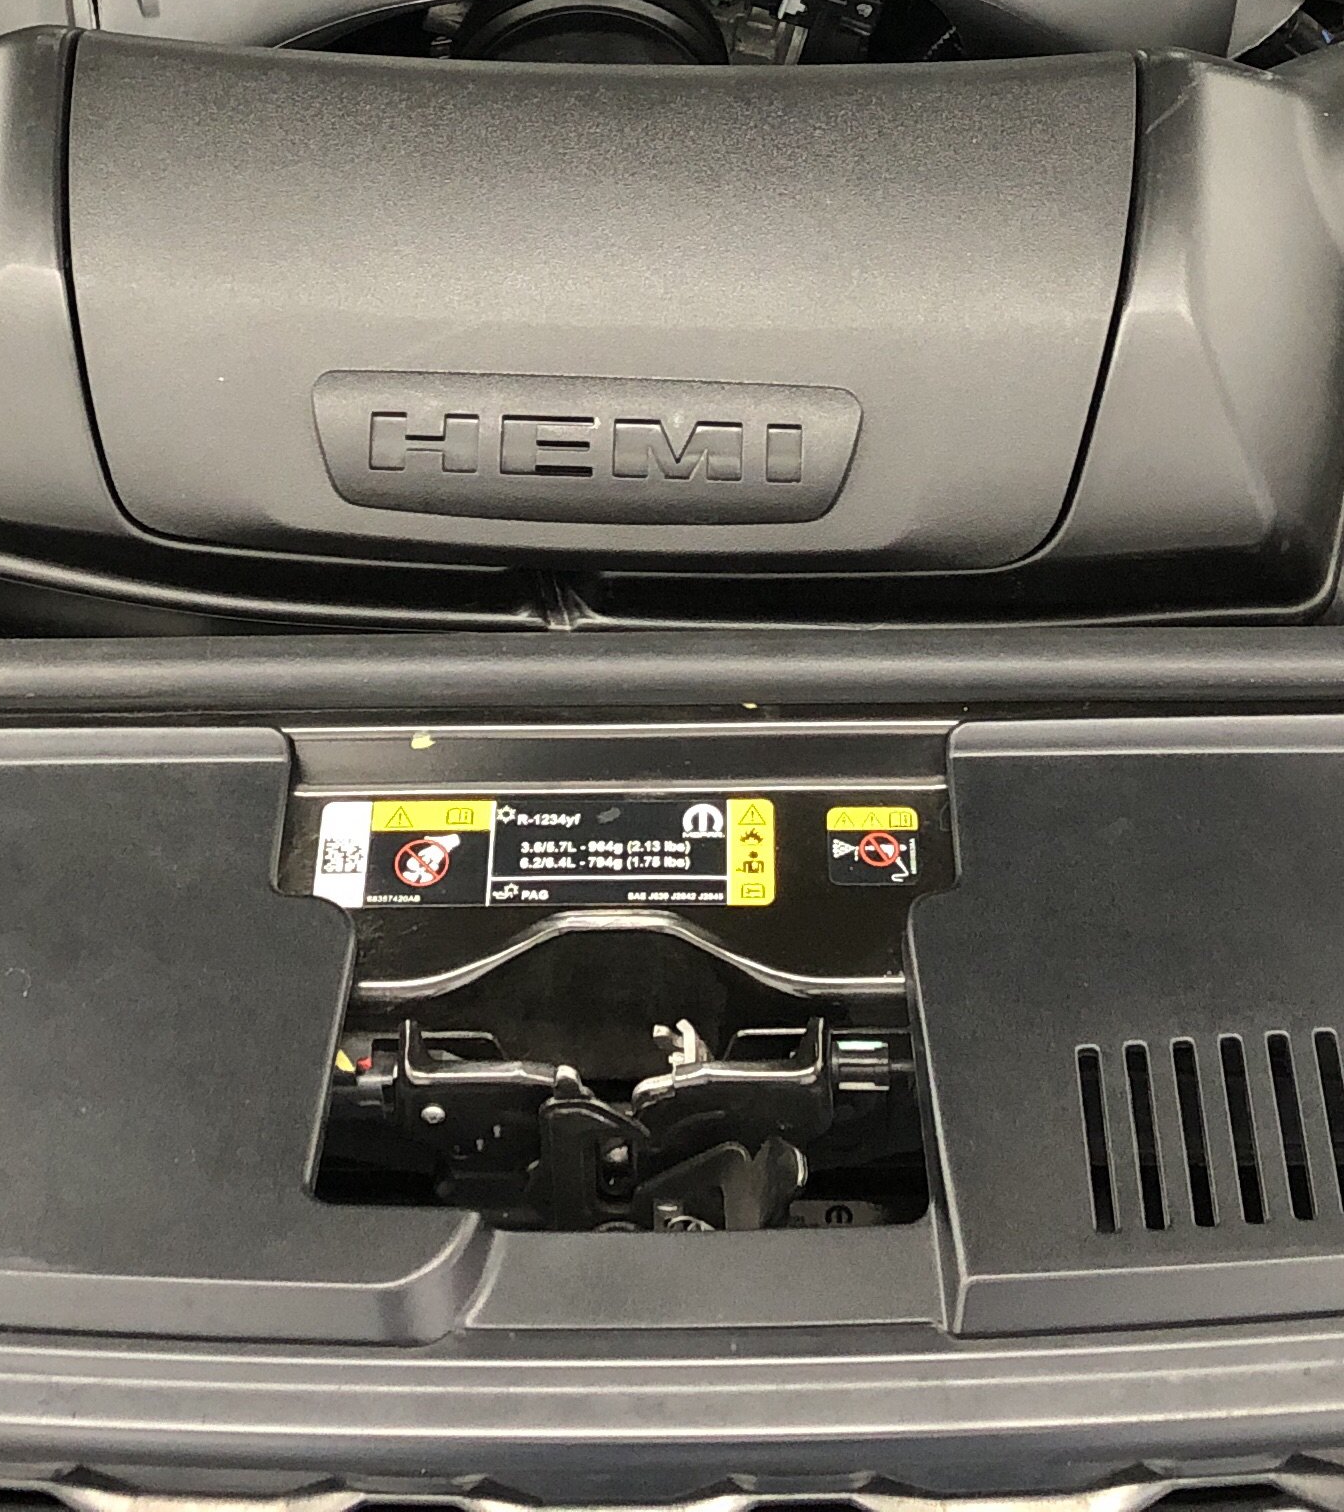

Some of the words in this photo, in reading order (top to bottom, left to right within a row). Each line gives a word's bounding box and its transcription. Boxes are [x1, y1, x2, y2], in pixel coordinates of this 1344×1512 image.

[369, 411, 803, 483] HEMI
[516, 813, 582, 828] R-1234yf
[626, 840, 661, 854] (2.13
[664, 840, 691, 854] lbs)
[664, 856, 691, 870] lbs)
[520, 890, 549, 900] PAG
